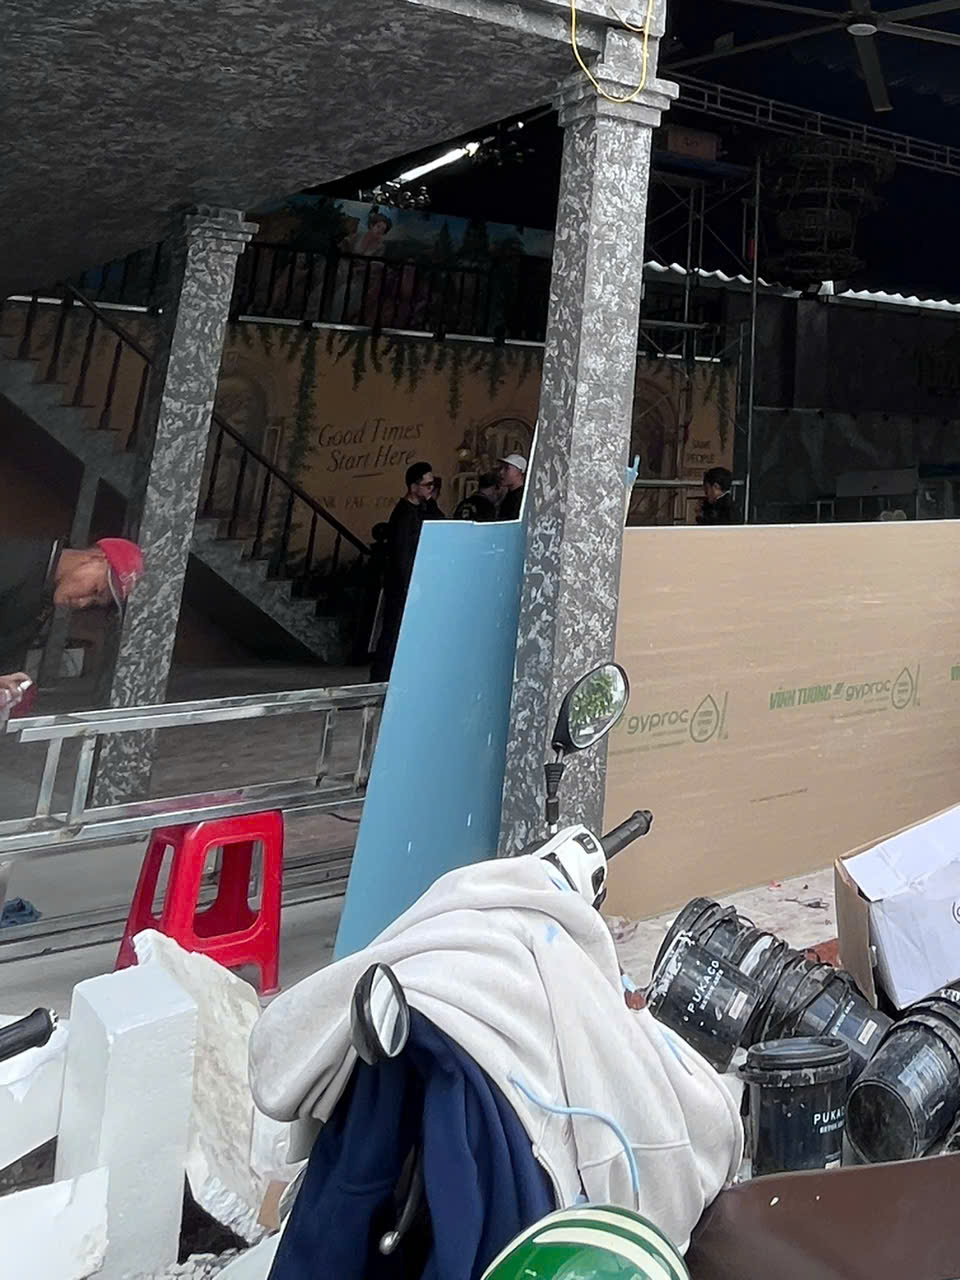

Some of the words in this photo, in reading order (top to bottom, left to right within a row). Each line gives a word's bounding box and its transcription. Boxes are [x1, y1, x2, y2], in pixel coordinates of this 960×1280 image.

[318, 420, 367, 448] Good
[370, 417, 424, 443] Times
[326, 449, 370, 473] Start
[374, 444, 417, 468] Here
[845, 680, 891, 701] gyproc
[627, 709, 689, 735] gyproc
[687, 960, 720, 1013] PUKACO
